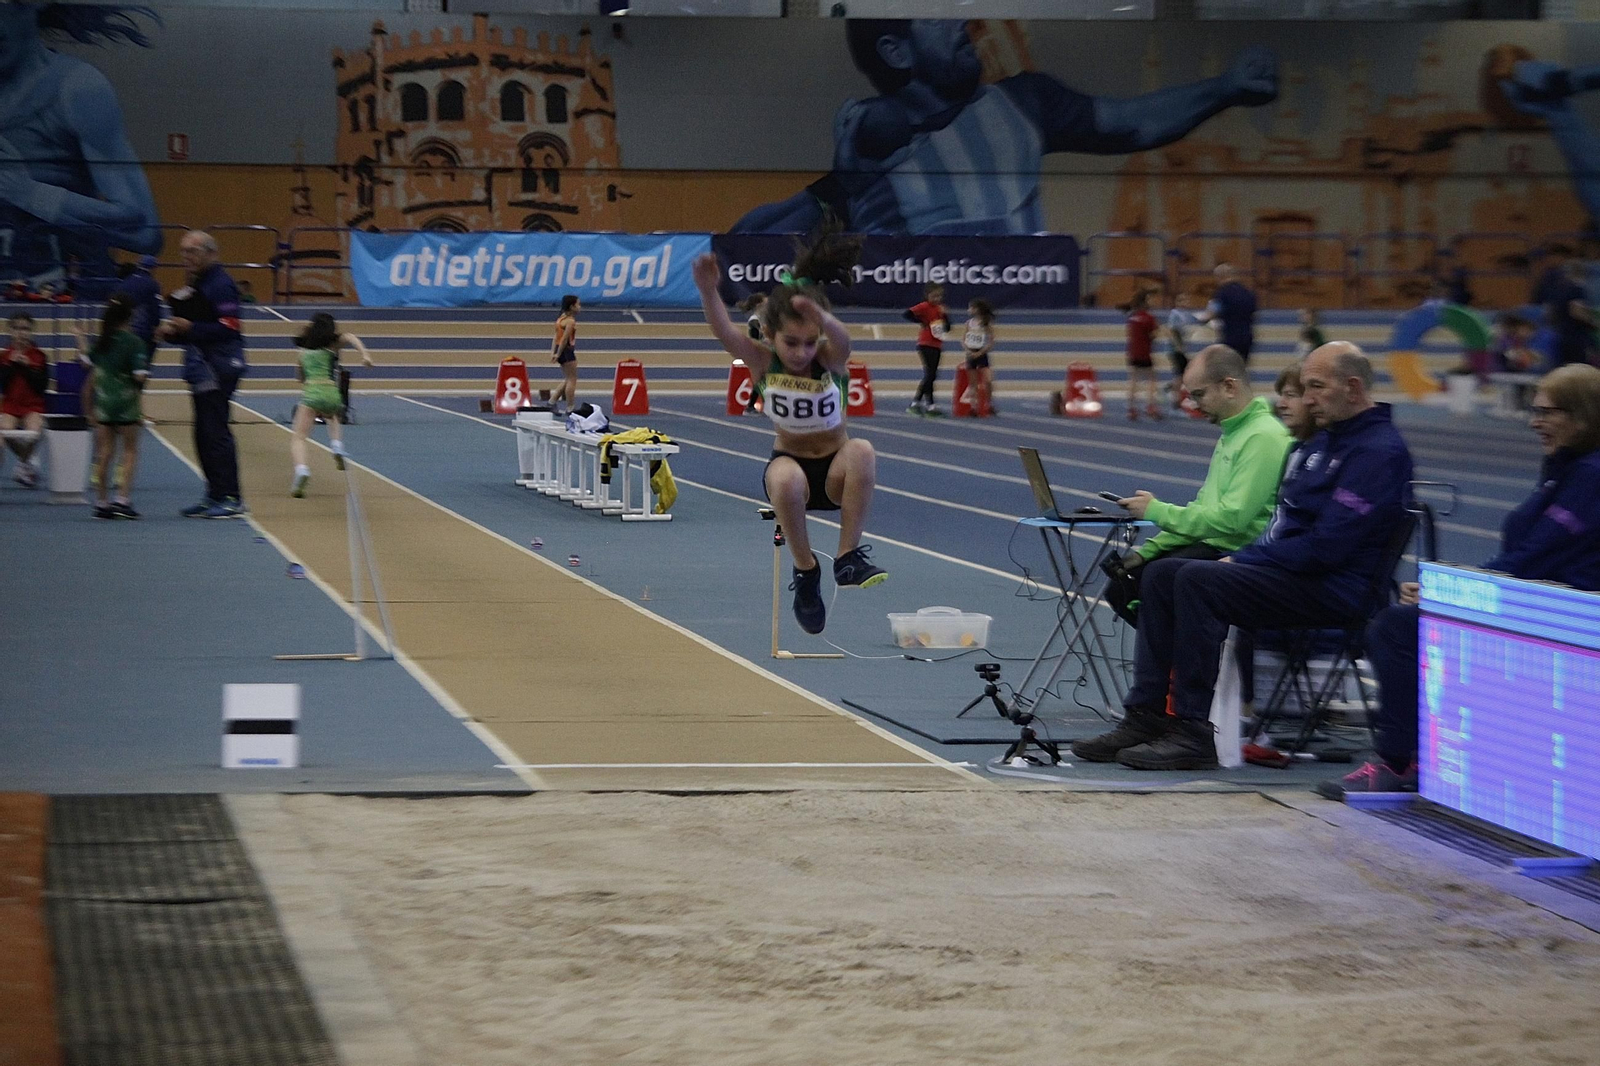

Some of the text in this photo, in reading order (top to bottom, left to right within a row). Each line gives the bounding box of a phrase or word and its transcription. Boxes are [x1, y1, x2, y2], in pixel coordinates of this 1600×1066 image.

[389, 243, 672, 297] atletismo.gal
[728, 258, 1071, 285] euron-athletics.com
[504, 377, 522, 405] 8
[621, 378, 640, 405] 7
[735, 378, 753, 406] 6
[847, 379, 866, 405] 5
[771, 393, 835, 419] 686
